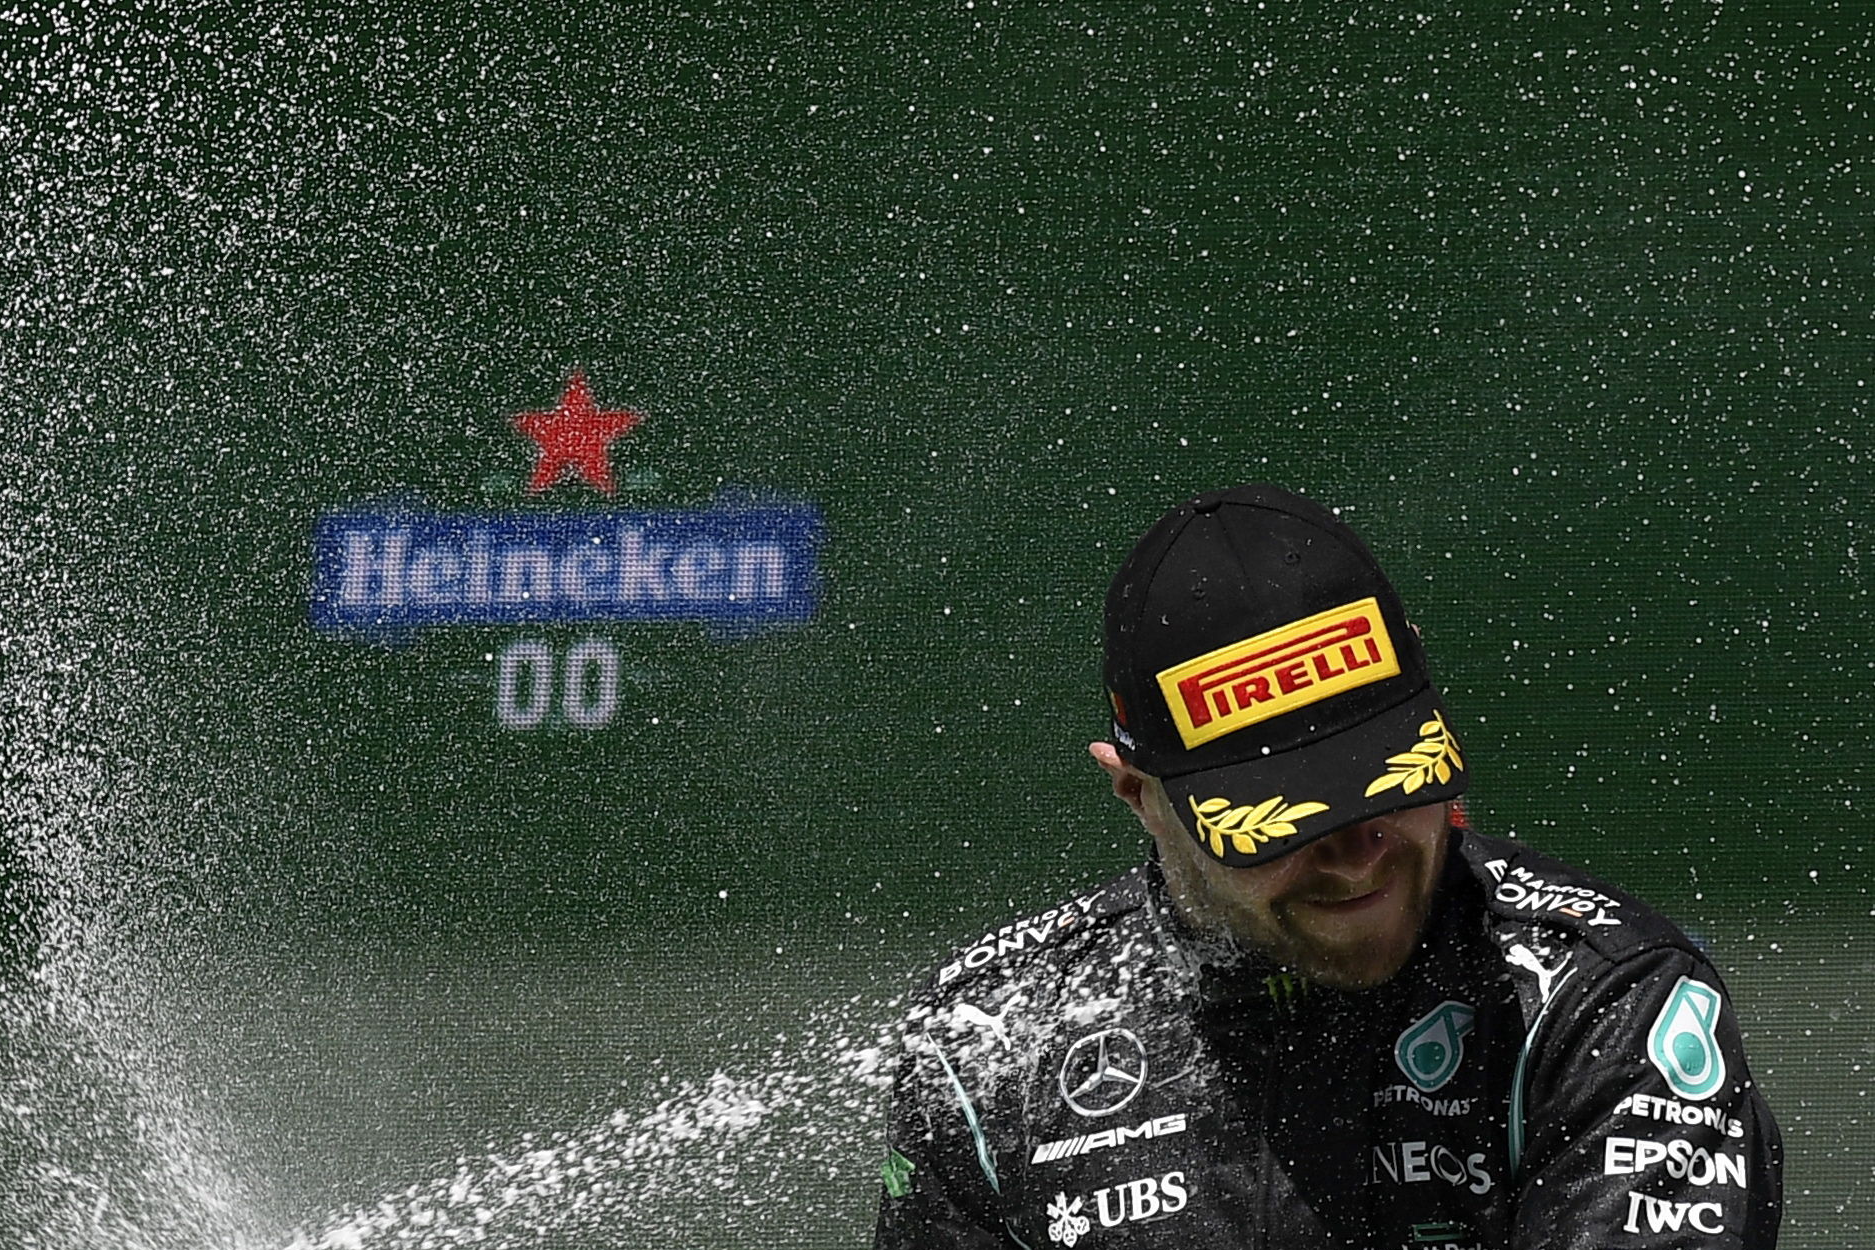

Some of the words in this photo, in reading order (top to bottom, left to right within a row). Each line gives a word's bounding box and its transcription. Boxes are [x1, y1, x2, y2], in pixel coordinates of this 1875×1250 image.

[342, 527, 788, 604] Heineken
[1176, 615, 1383, 730] PIRELLI
[1079, 1113, 1188, 1156] AMG
[1363, 1140, 1493, 1195] NEOS
[1603, 1136, 1747, 1190] EPSON
[1092, 1171, 1188, 1229] UBS
[1623, 1190, 1725, 1235] IWC
